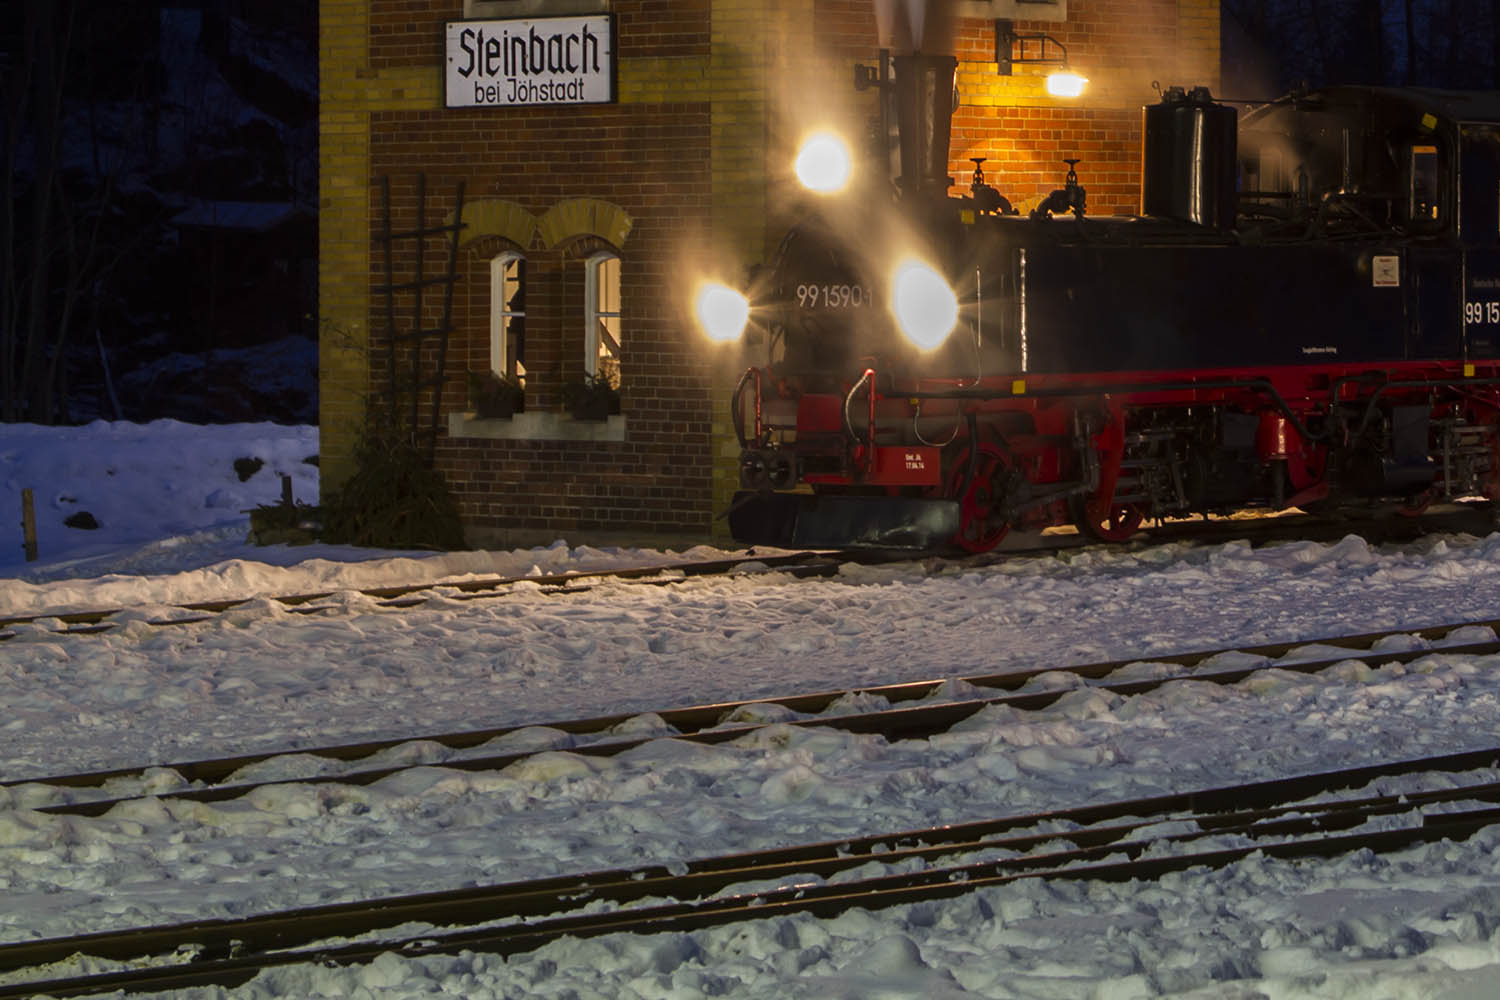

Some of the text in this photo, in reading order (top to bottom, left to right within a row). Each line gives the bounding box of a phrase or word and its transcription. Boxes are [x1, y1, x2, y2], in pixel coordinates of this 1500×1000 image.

[457, 23, 600, 78] Steinbach
[474, 78, 585, 104] bei Jöhstadt
[796, 284, 819, 308] 99
[1465, 301, 1483, 325] 99
